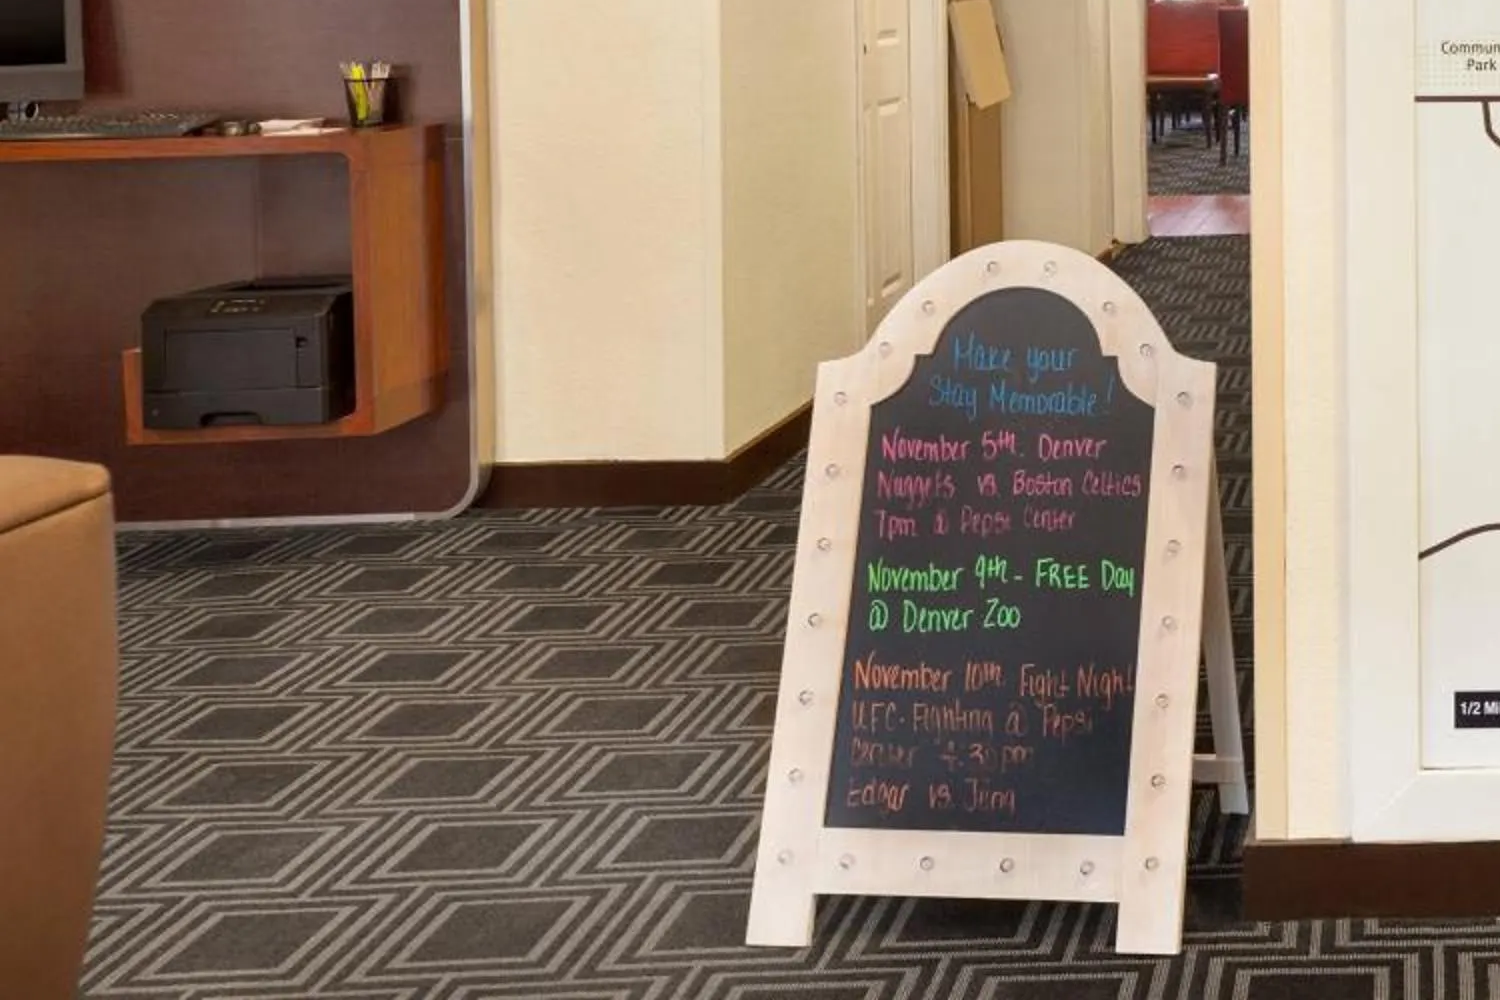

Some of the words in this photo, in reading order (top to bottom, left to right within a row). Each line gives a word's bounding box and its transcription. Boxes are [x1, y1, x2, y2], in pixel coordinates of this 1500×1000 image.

[1467, 58, 1497, 72] Park
[953, 331, 1012, 373] Make
[1027, 346, 1079, 384] your
[929, 375, 978, 420] Stay
[882, 428, 972, 463] November
[1039, 434, 1107, 460] Denver
[876, 471, 956, 509] Nuggets
[1013, 469, 1073, 497] Boston
[1081, 470, 1142, 498] Celtics
[874, 509, 917, 540] 7pm
[961, 505, 1012, 538] Pepsi
[1024, 506, 1076, 531] Center
[867, 560, 963, 593] November
[975, 553, 1008, 589] 9th
[1035, 556, 1090, 589] FREE
[1101, 558, 1135, 597] Day
[868, 601, 889, 632] @
[902, 599, 975, 633] Denver
[983, 598, 1021, 629] Zoo
[854, 650, 952, 692] November
[965, 661, 1005, 691] 10th
[1019, 663, 1070, 708] Fight
[913, 700, 993, 744] Fighting
[1043, 703, 1094, 745] Pepsi
[1460, 701, 1479, 716] 1/2
[847, 777, 911, 819] Edgar
